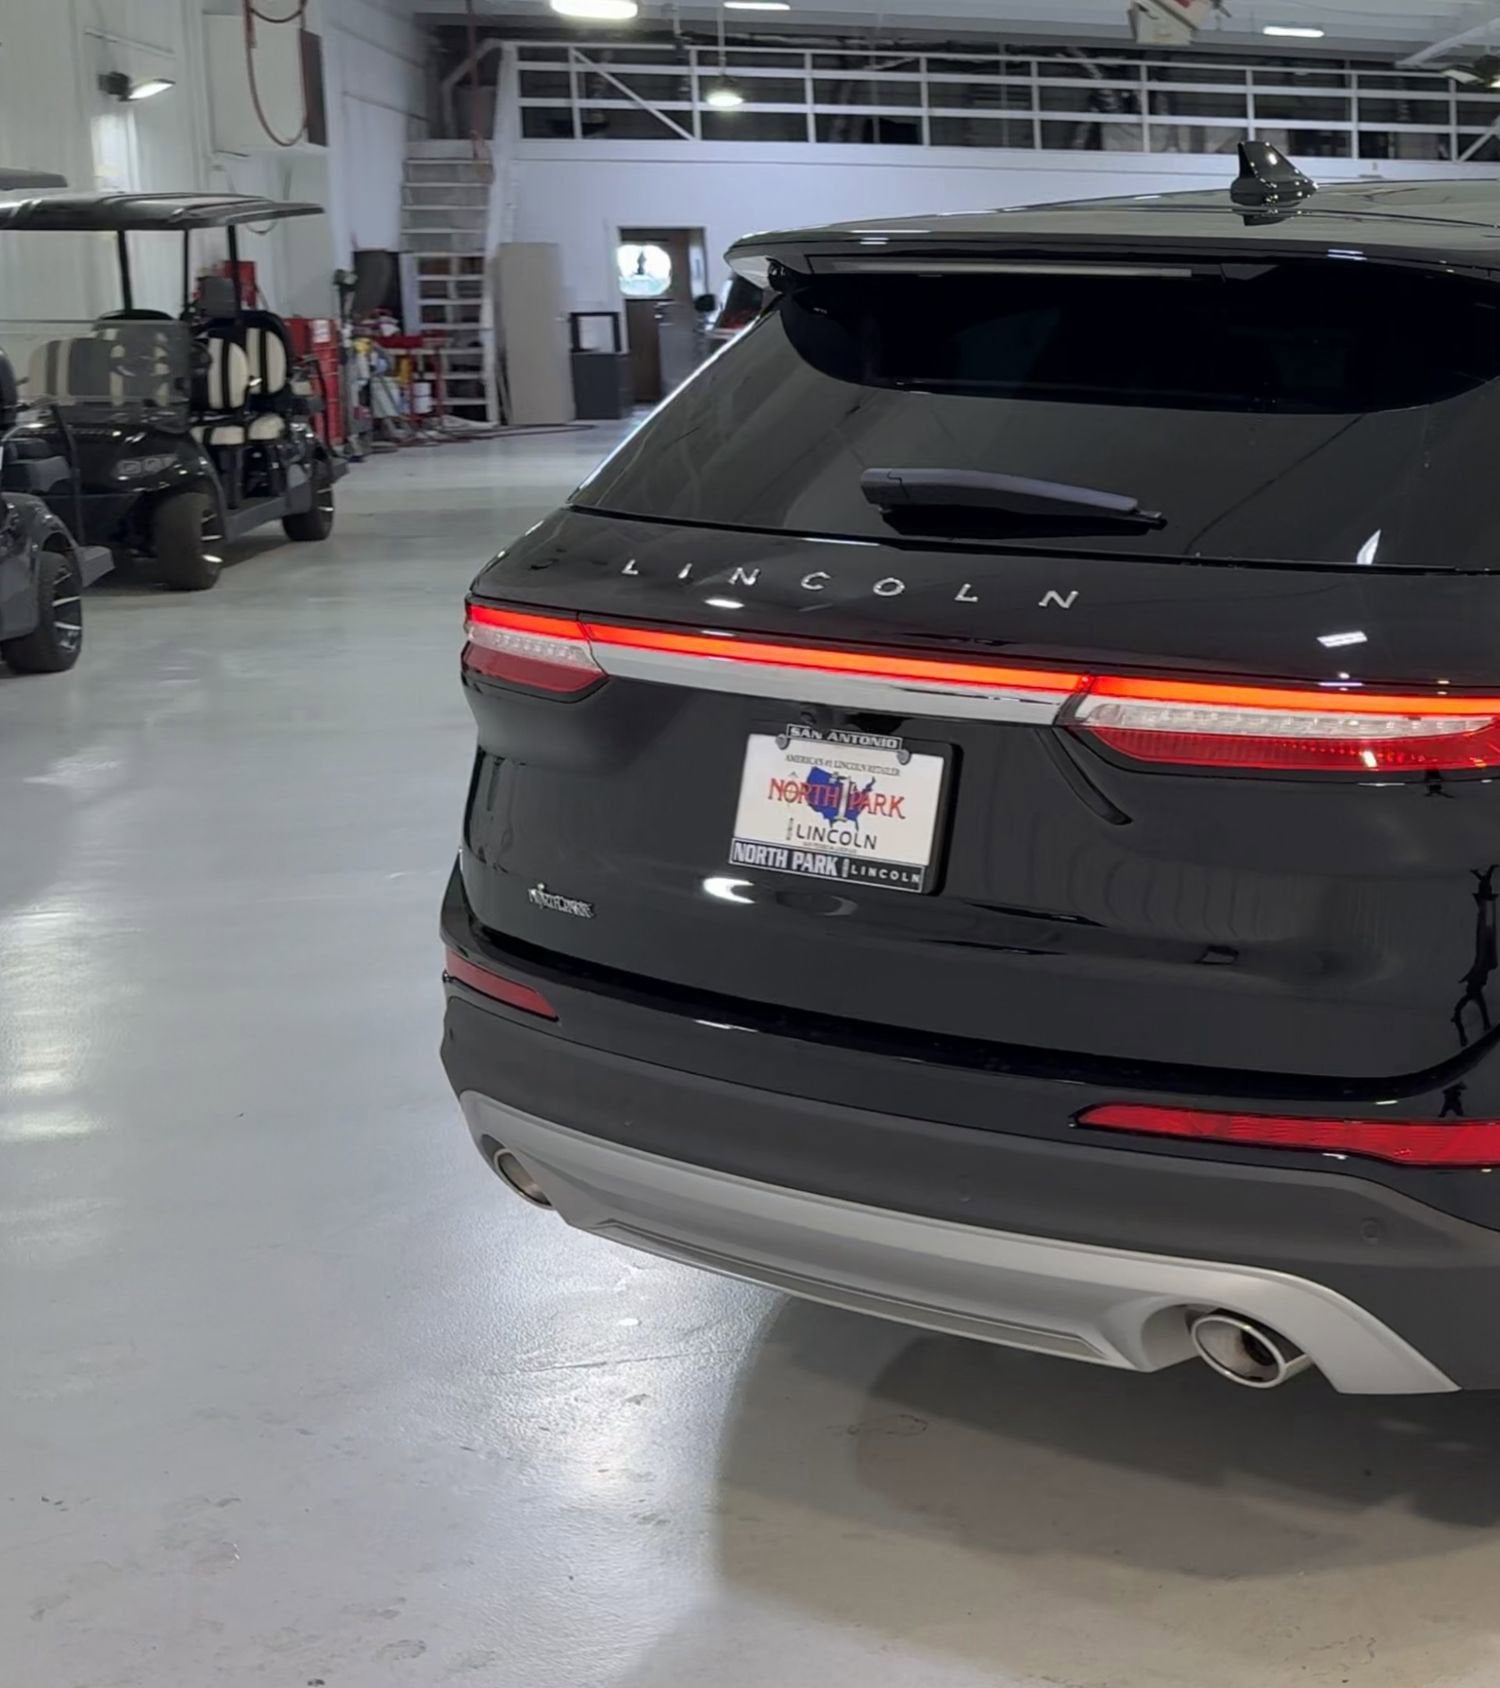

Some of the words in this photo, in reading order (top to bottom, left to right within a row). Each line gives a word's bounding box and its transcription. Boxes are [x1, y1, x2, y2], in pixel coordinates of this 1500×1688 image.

[621, 559, 1079, 609] LINCOLN
[789, 727, 823, 741] SAN
[826, 731, 898, 749] ANTONIO
[768, 778, 838, 808] NORTH
[848, 788, 906, 820] PARK
[796, 823, 877, 850] LINCOLN
[733, 842, 788, 868] NORTH
[791, 851, 839, 876] PARK
[851, 865, 920, 883] LINCOLN
